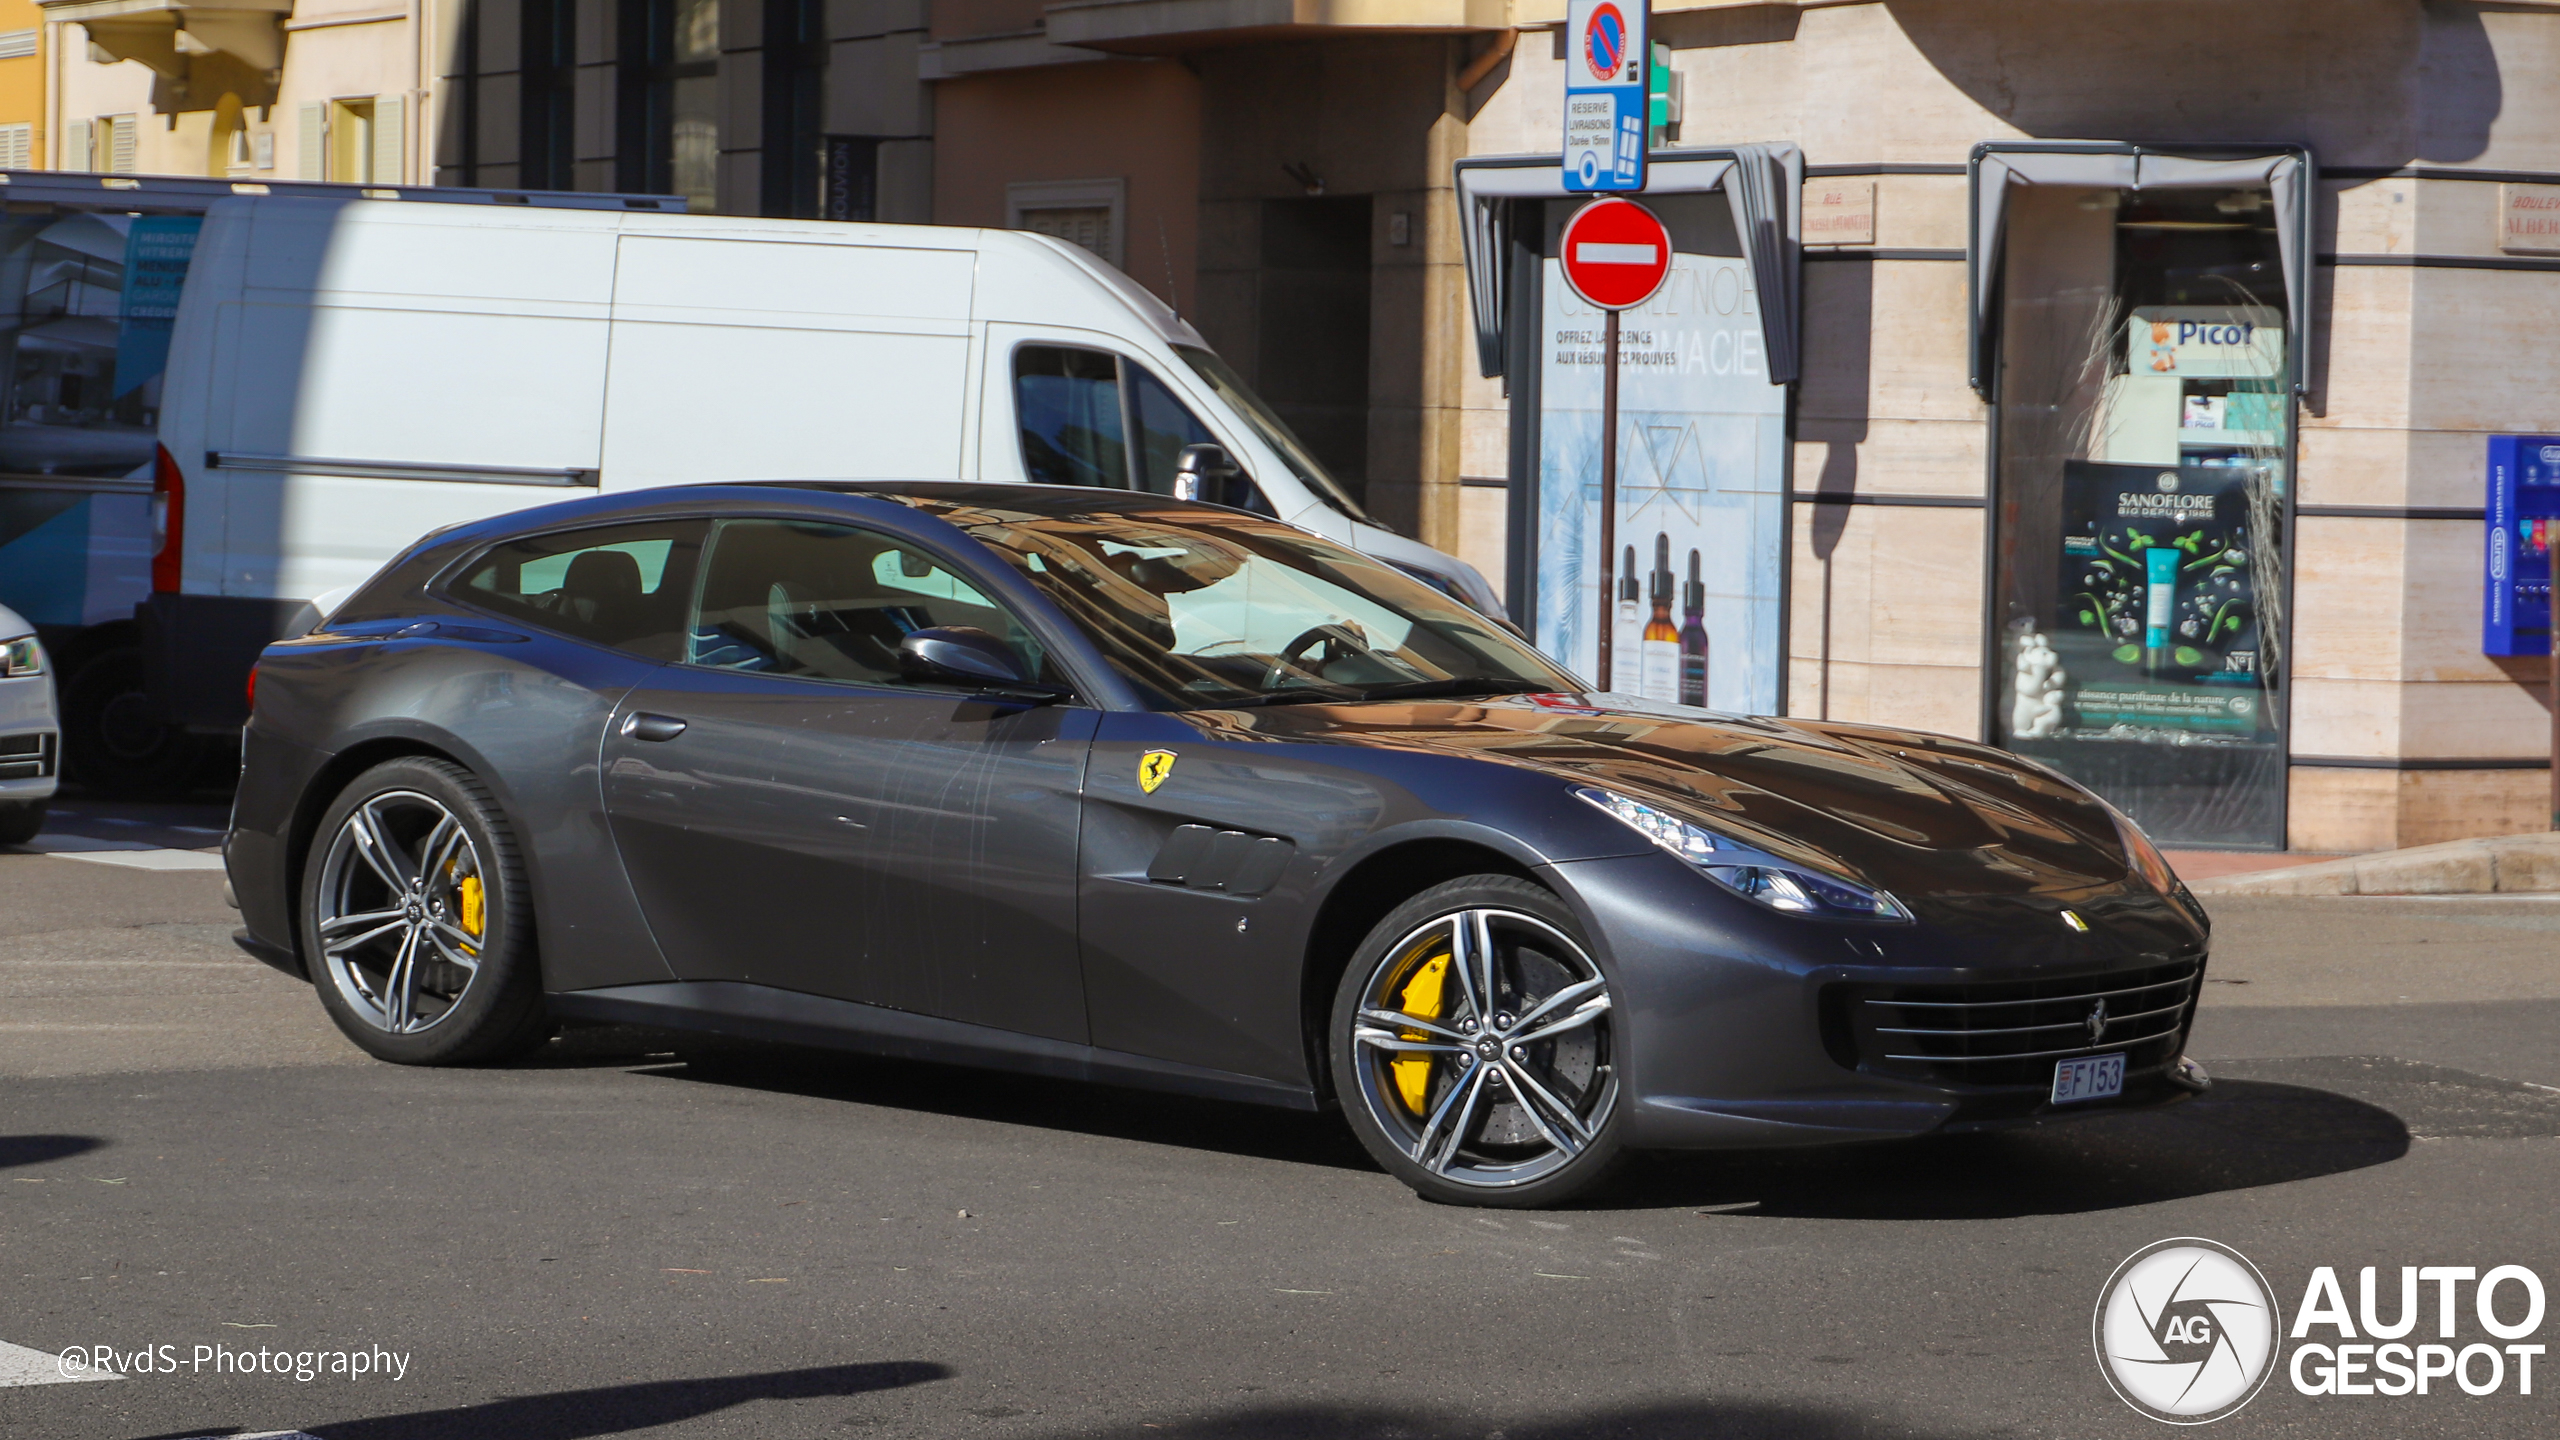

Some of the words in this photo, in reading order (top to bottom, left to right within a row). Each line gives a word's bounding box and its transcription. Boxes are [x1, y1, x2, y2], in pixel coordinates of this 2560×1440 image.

[1571, 100, 1608, 113] RÉSERVÉ
[1569, 119, 1611, 130] LIVRAISONS
[1569, 135, 1589, 146] Durée
[1823, 193, 1843, 204] RUE
[1692, 265, 1755, 316] NOE
[1556, 330, 1592, 344] OFFREZ
[1617, 331, 1652, 344] CIENCE
[2177, 318, 2254, 345] Picot
[1555, 351, 1576, 364] AUX
[2118, 492, 2214, 510] SANOFLORE
[2117, 507, 2140, 516] BIO
[2493, 532, 2504, 575] durex
[2119, 690, 2166, 702] purifiante
[2168, 691, 2180, 702] de
[2182, 692, 2191, 702] la
[2071, 1059, 2120, 1095] F153
